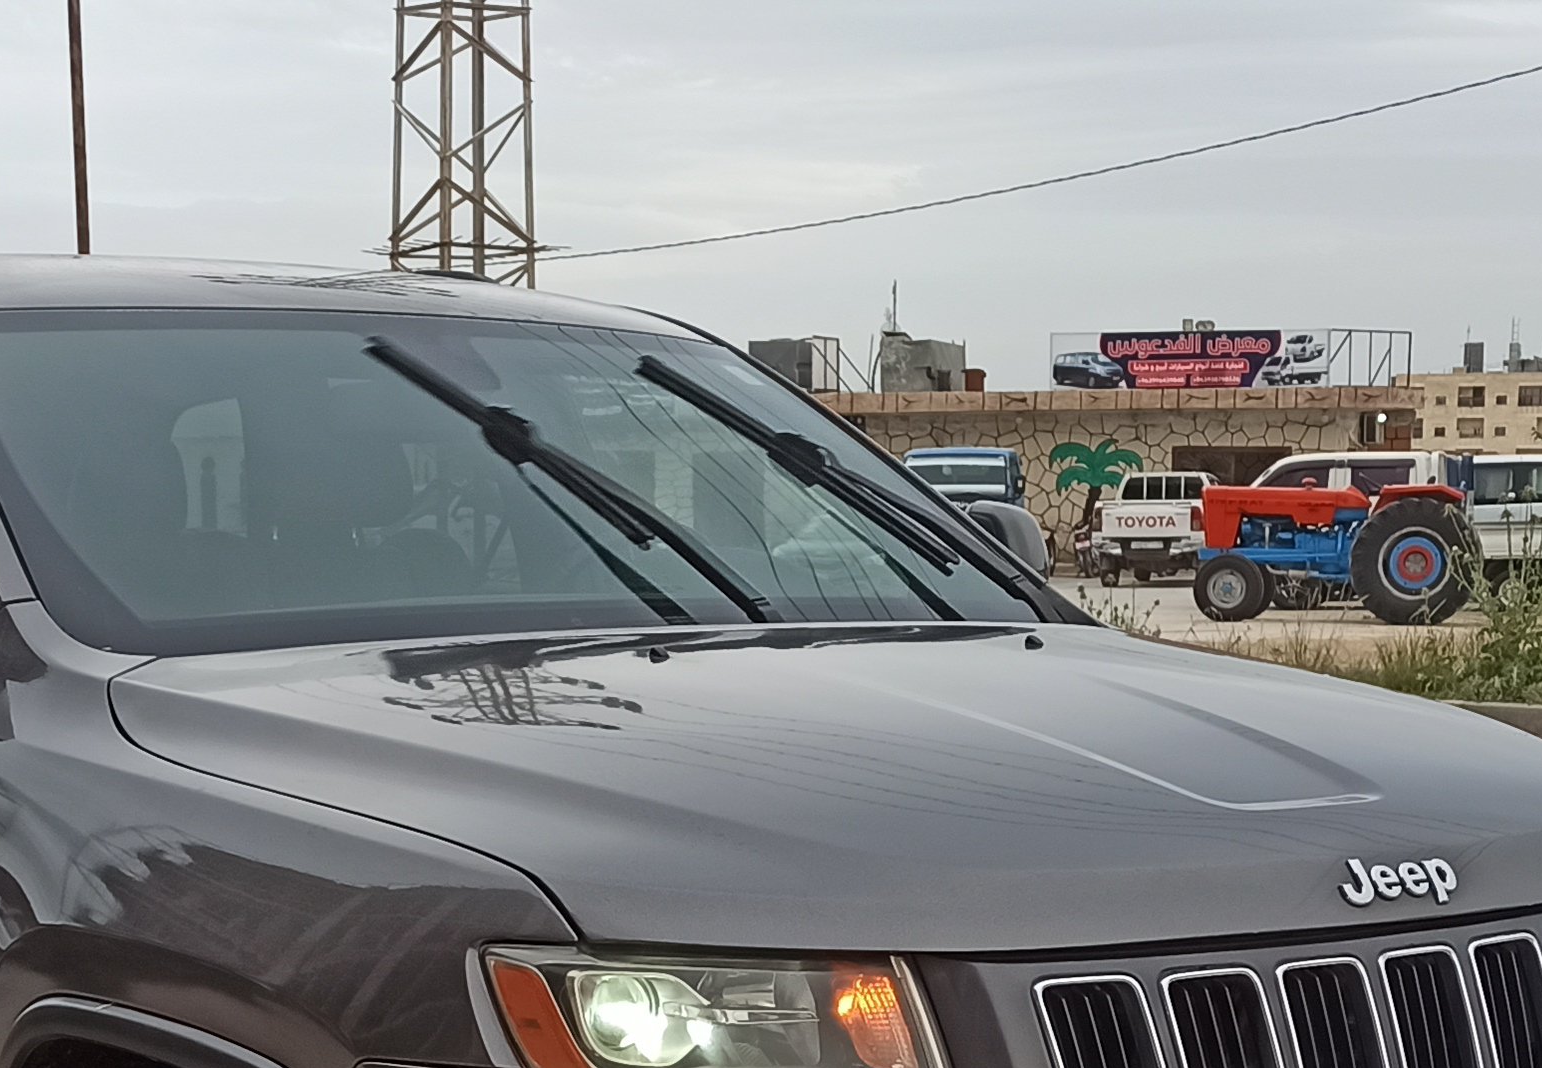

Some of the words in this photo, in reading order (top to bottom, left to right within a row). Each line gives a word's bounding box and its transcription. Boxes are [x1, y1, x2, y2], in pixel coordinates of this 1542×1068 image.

[1207, 334, 1271, 357] معرض
[1115, 516, 1176, 528] TOYOTA
[1339, 858, 1458, 905] Jeep
